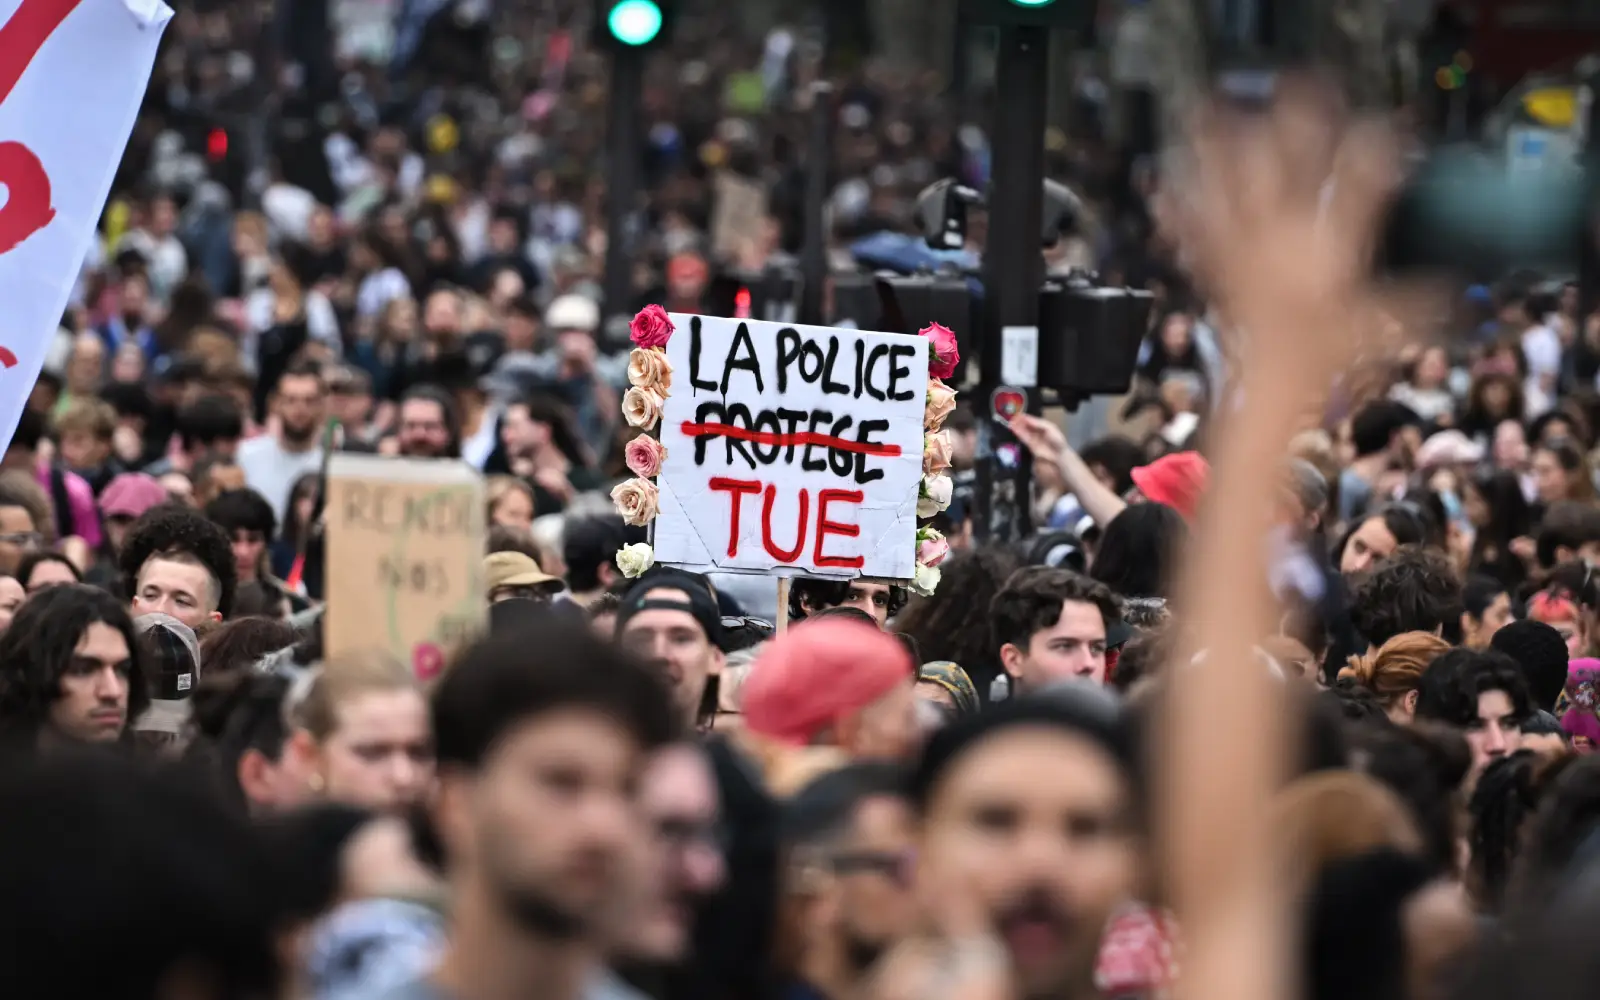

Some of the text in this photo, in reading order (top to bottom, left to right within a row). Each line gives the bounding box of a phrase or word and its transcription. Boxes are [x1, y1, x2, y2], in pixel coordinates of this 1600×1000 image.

[689, 316, 764, 394] LA
[776, 327, 915, 401] POLICE
[694, 402, 890, 484] PROTEGE
[708, 476, 865, 568] TUE
